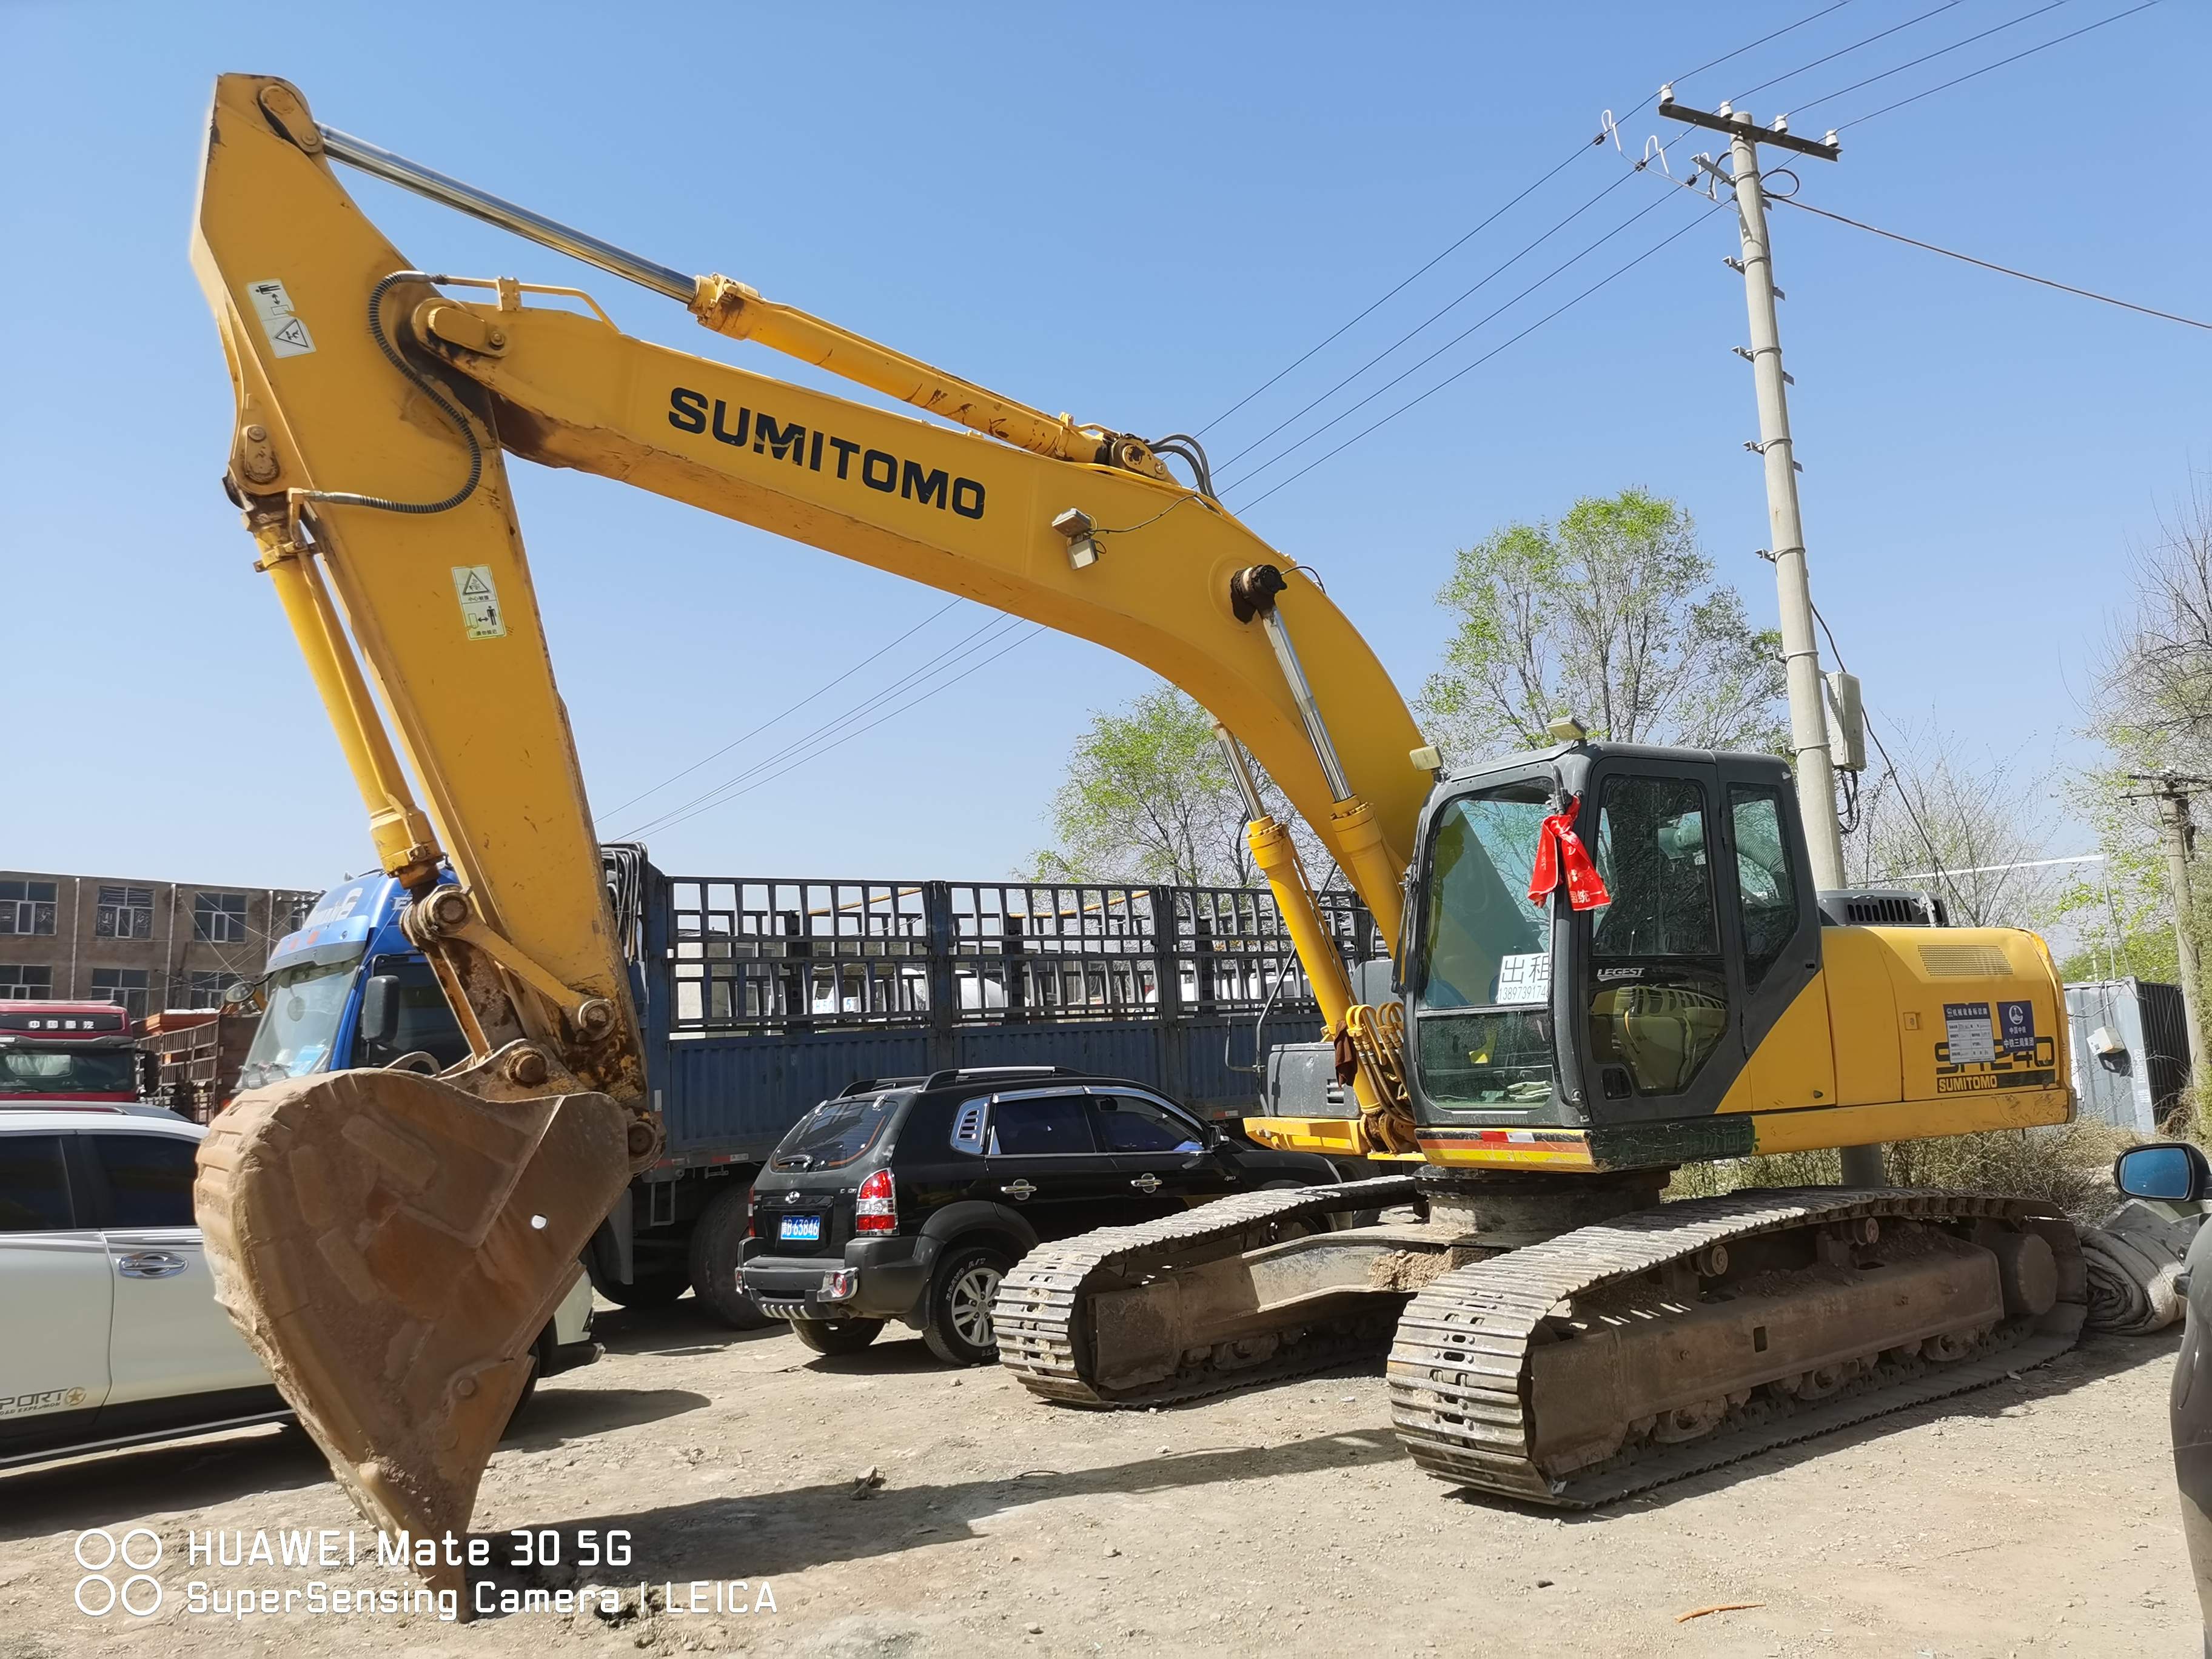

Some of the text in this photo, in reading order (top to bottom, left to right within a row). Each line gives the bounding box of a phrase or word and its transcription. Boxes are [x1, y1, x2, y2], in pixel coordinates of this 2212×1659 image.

[668, 387, 985, 520] SUMITOMO
[1501, 956, 1549, 984] 出租
[1597, 968, 1645, 977] LEGEST
[1939, 1074, 1998, 1092] SUMITOMO
